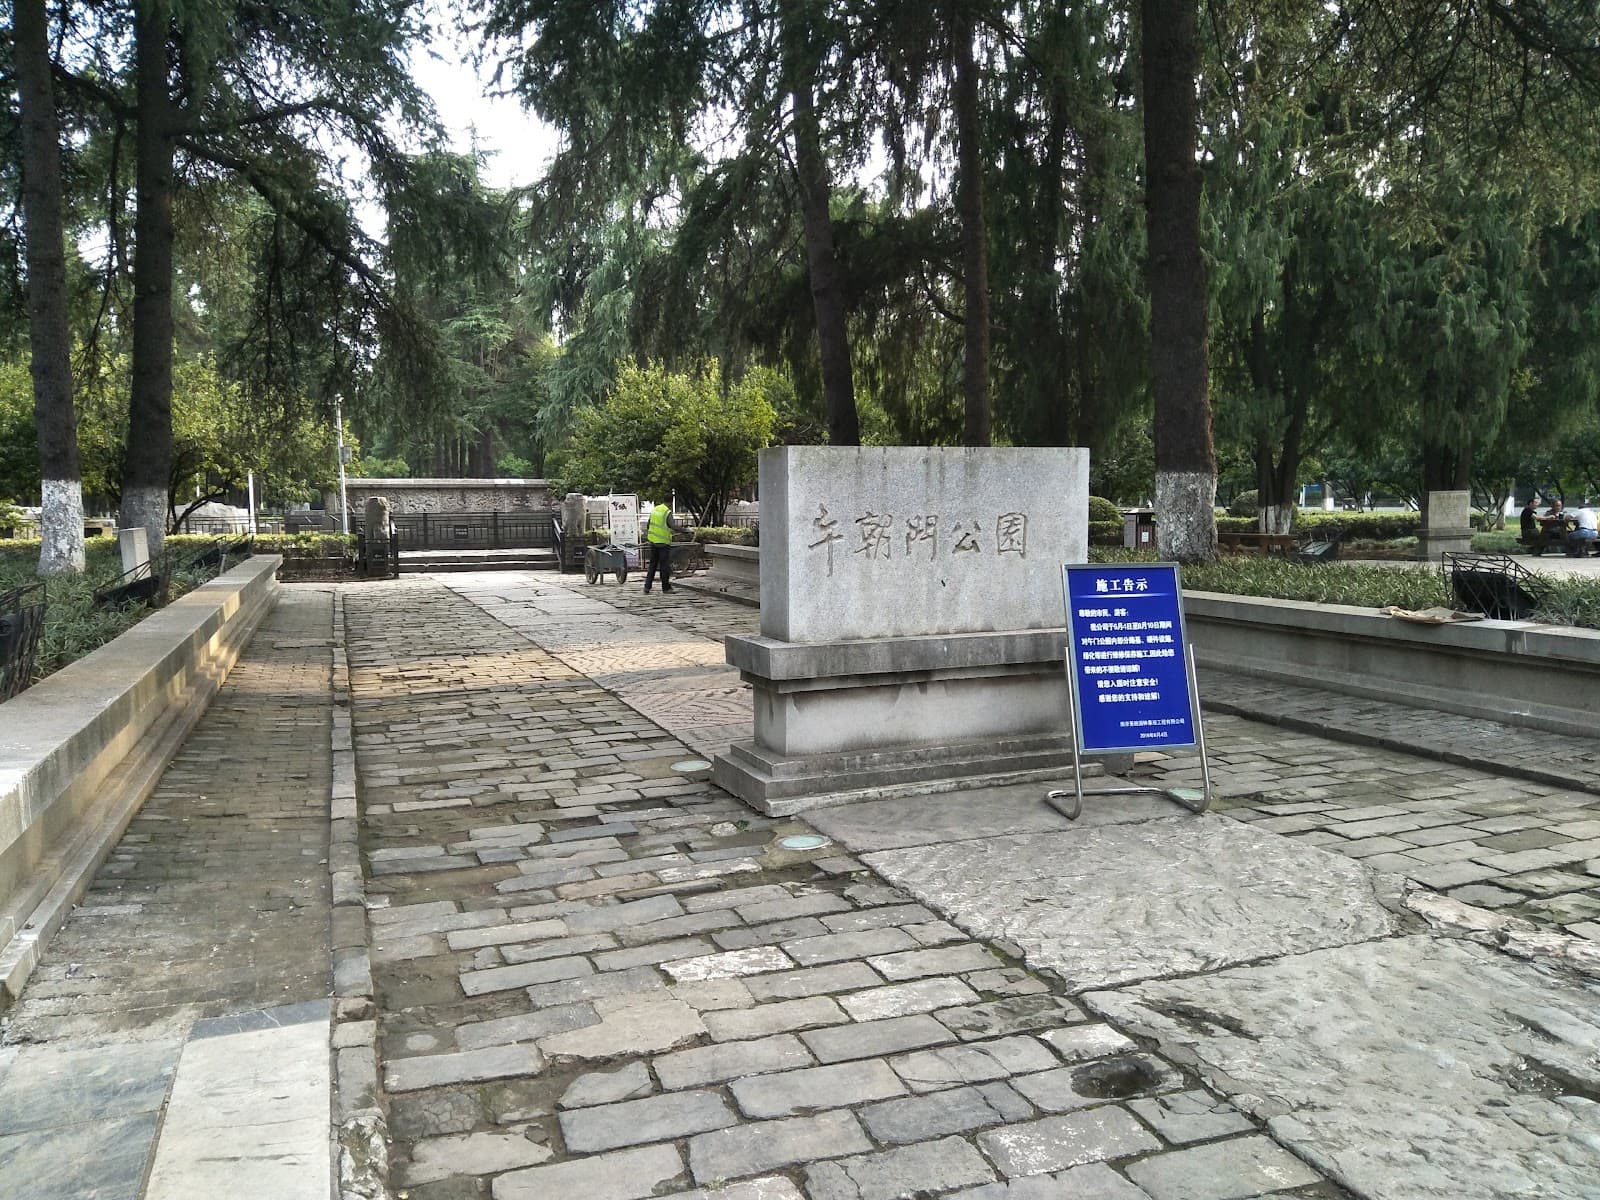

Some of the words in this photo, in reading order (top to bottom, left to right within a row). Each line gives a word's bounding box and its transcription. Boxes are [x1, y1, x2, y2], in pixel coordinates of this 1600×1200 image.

[808, 502, 1029, 577] 午朝門公園
[1095, 578, 1149, 593] 施工告示
